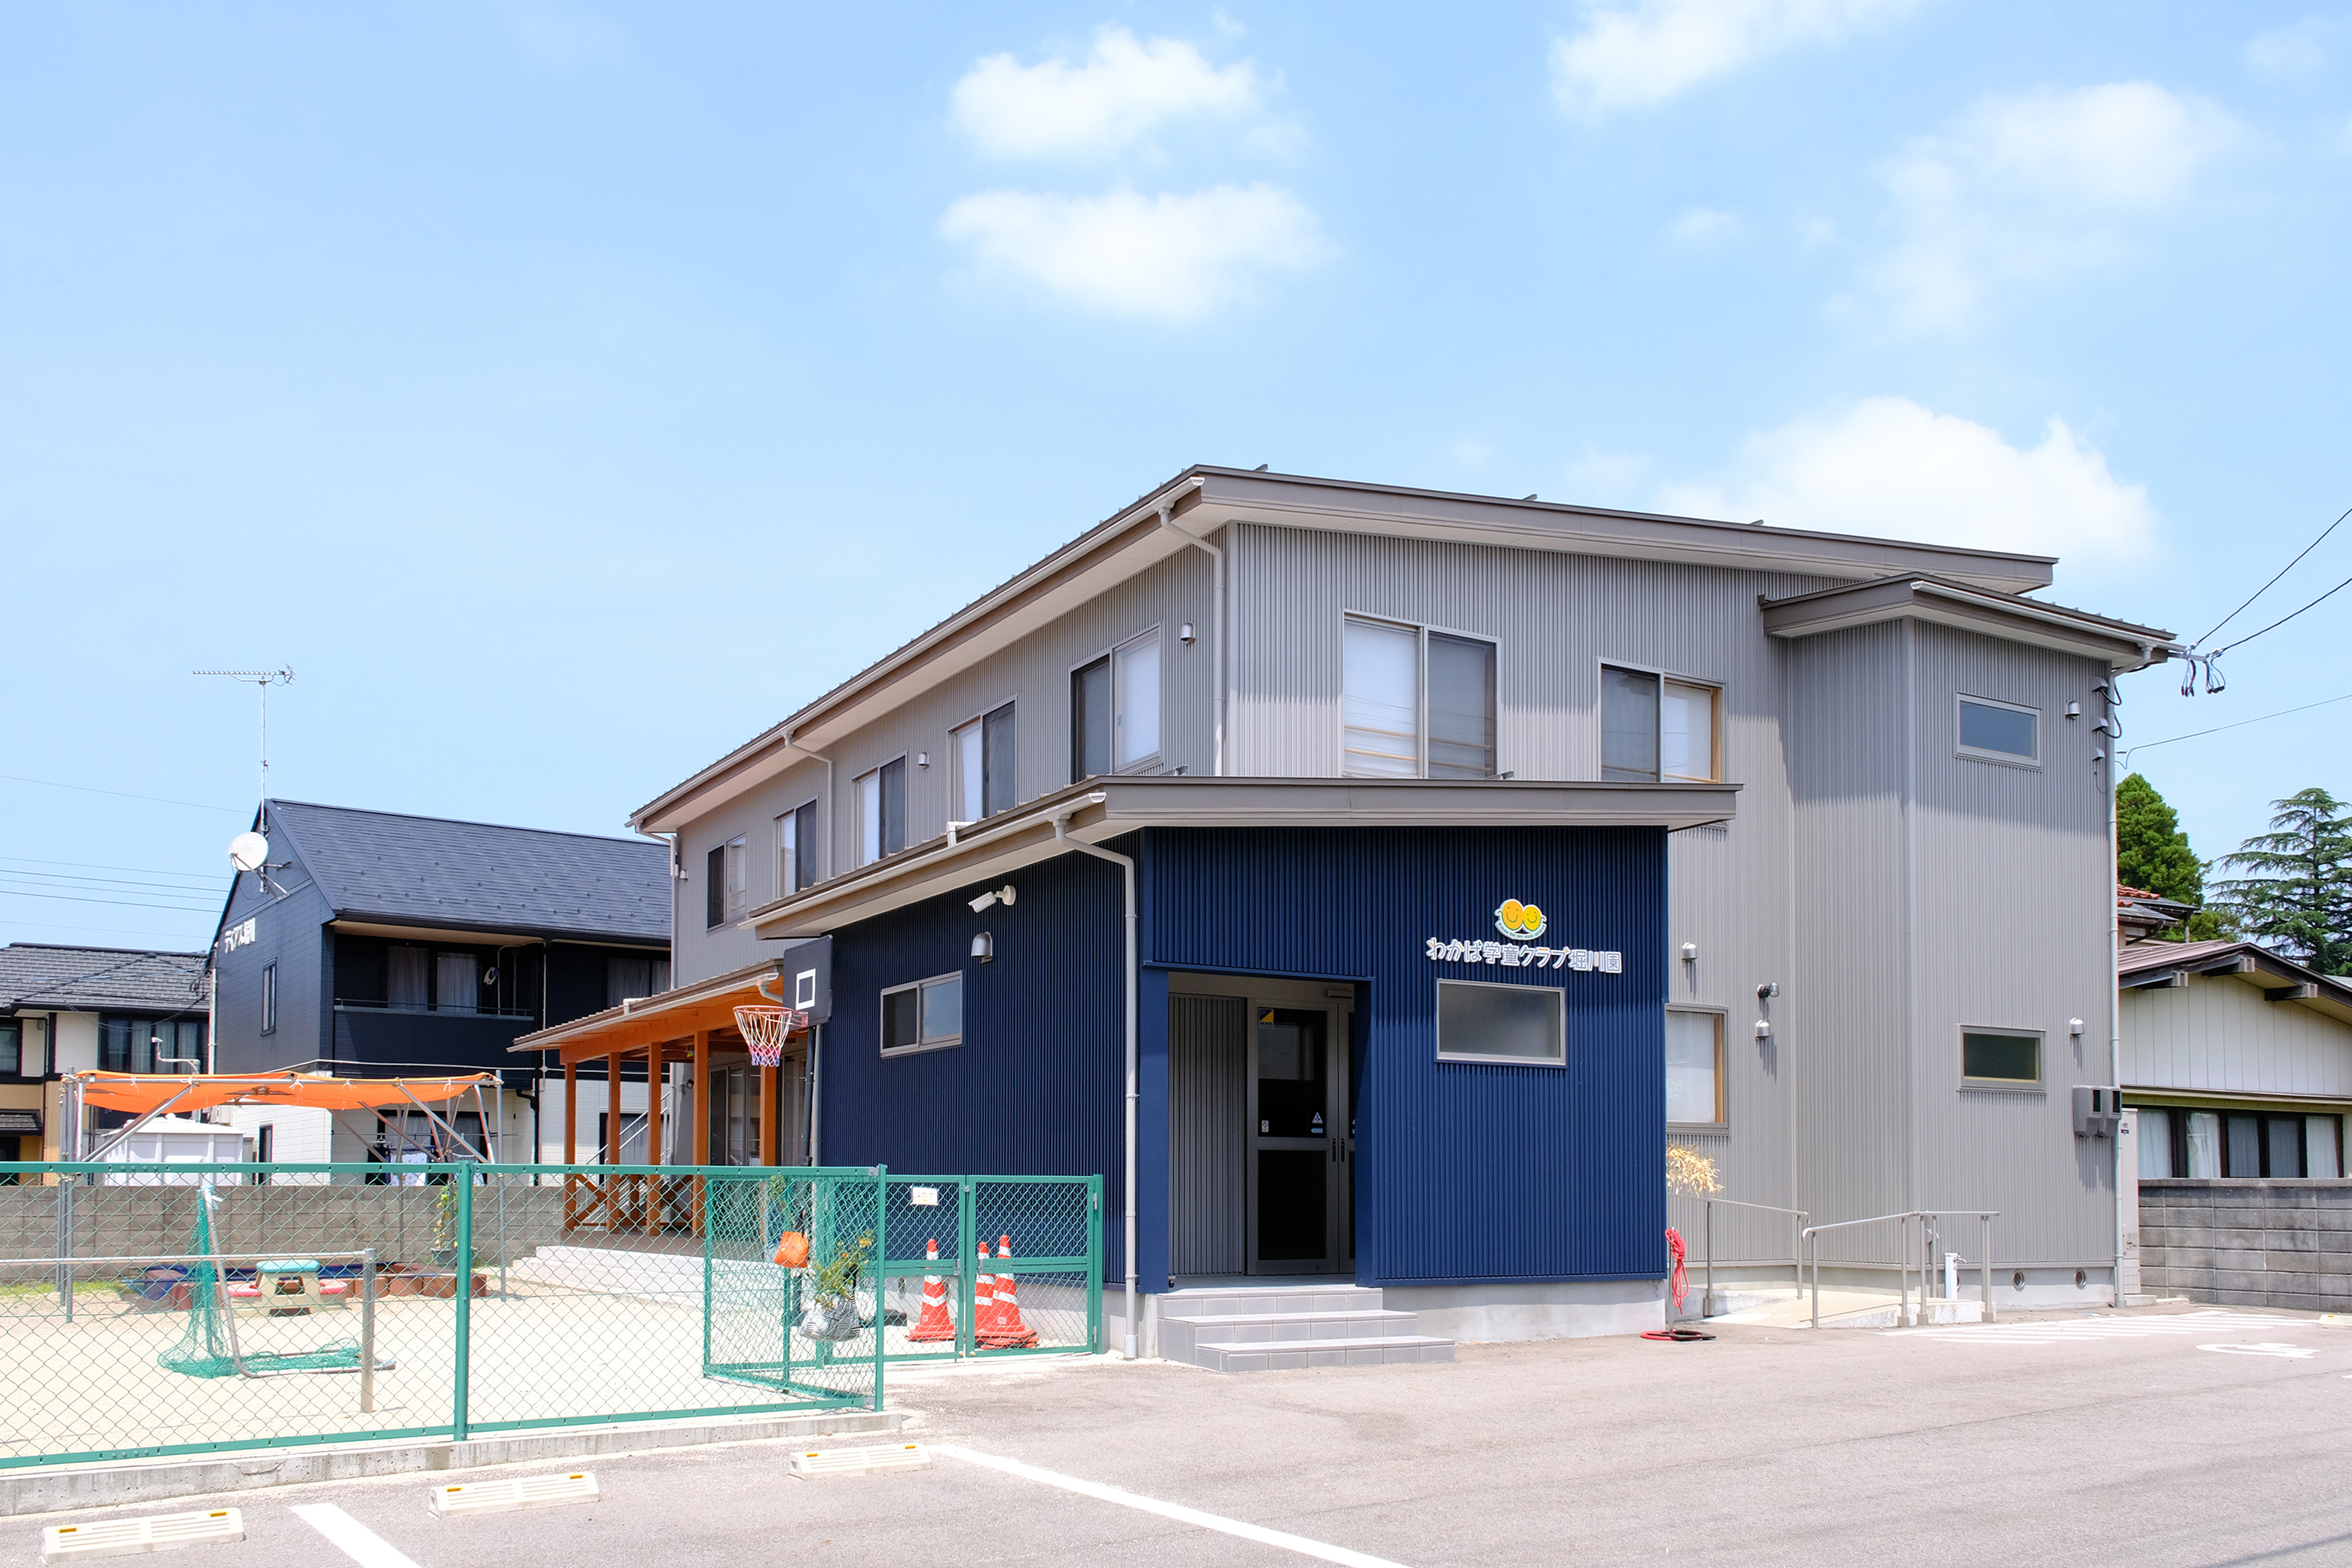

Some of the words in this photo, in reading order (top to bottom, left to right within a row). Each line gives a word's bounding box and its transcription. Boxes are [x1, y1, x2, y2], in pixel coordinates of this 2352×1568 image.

[1426, 937, 1622, 973] わかば学童クラブ堀川園
